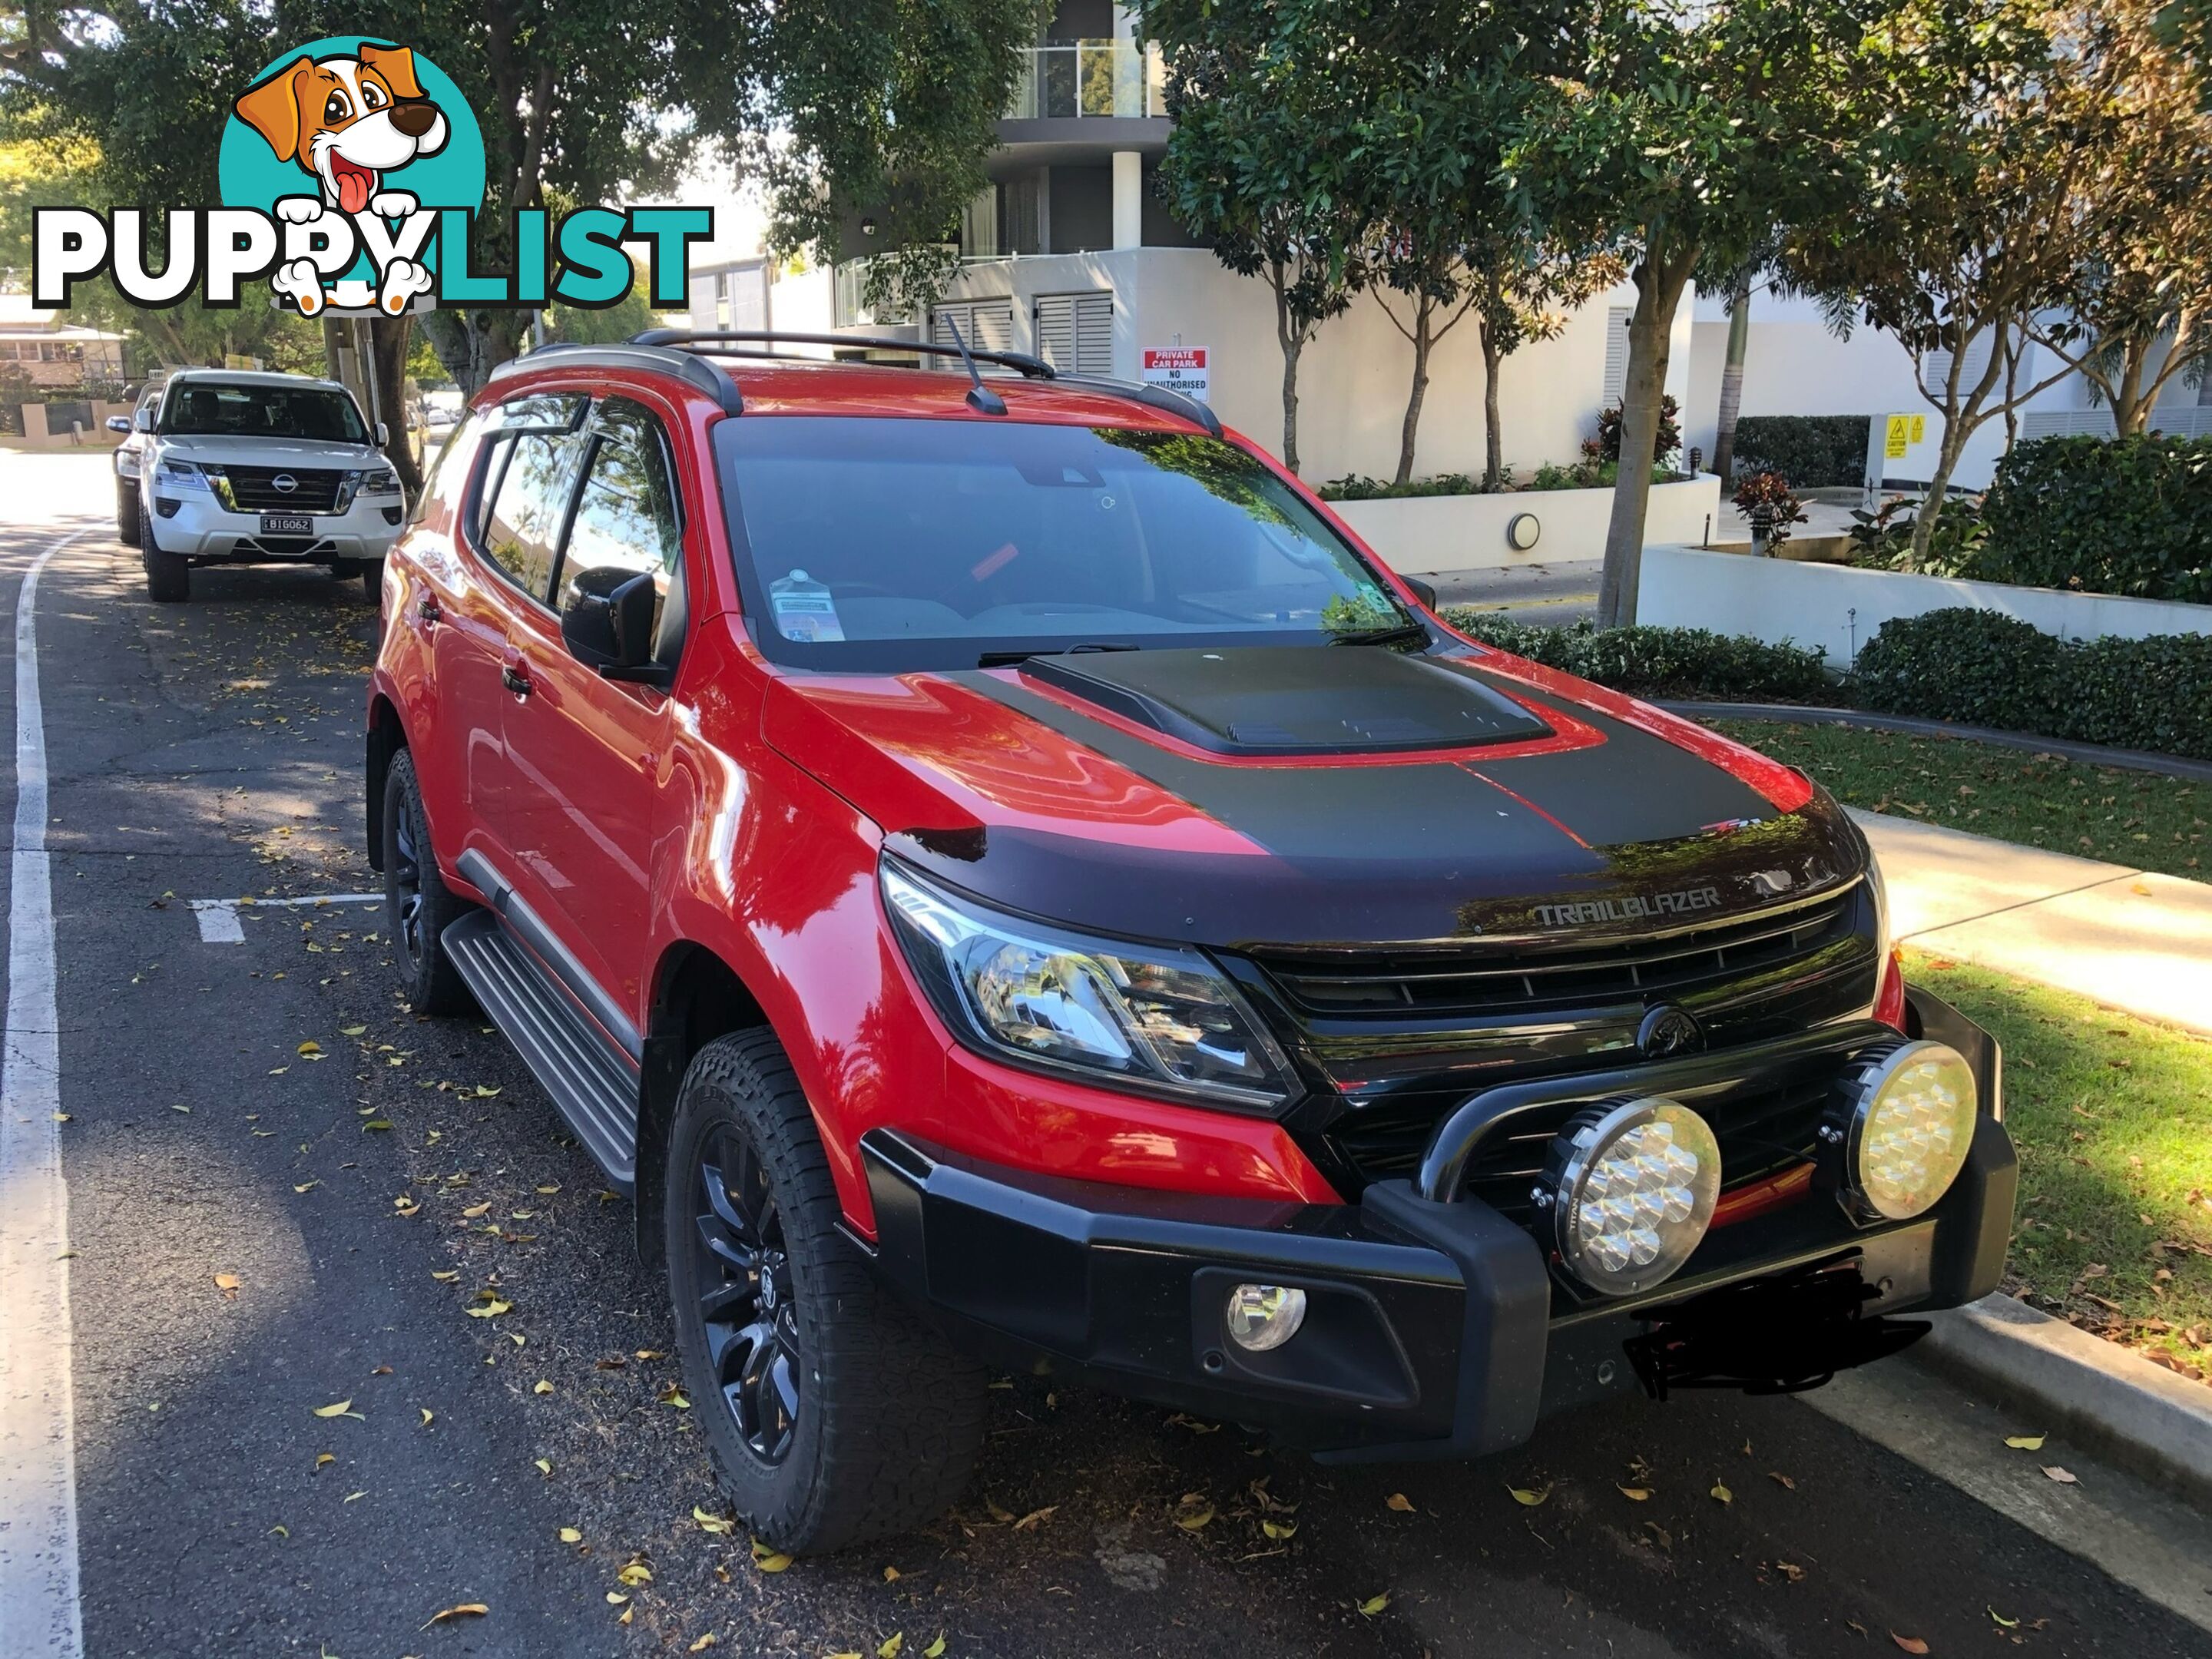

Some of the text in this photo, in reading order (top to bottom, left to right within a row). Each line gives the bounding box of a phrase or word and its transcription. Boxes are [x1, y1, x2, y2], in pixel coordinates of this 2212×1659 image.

[1156, 351, 1194, 359] PRIVATE
[1169, 369, 1181, 379] NO
[1535, 886, 1722, 926] TRAILBLAZER
[1569, 1197, 1579, 1230] TITAN
